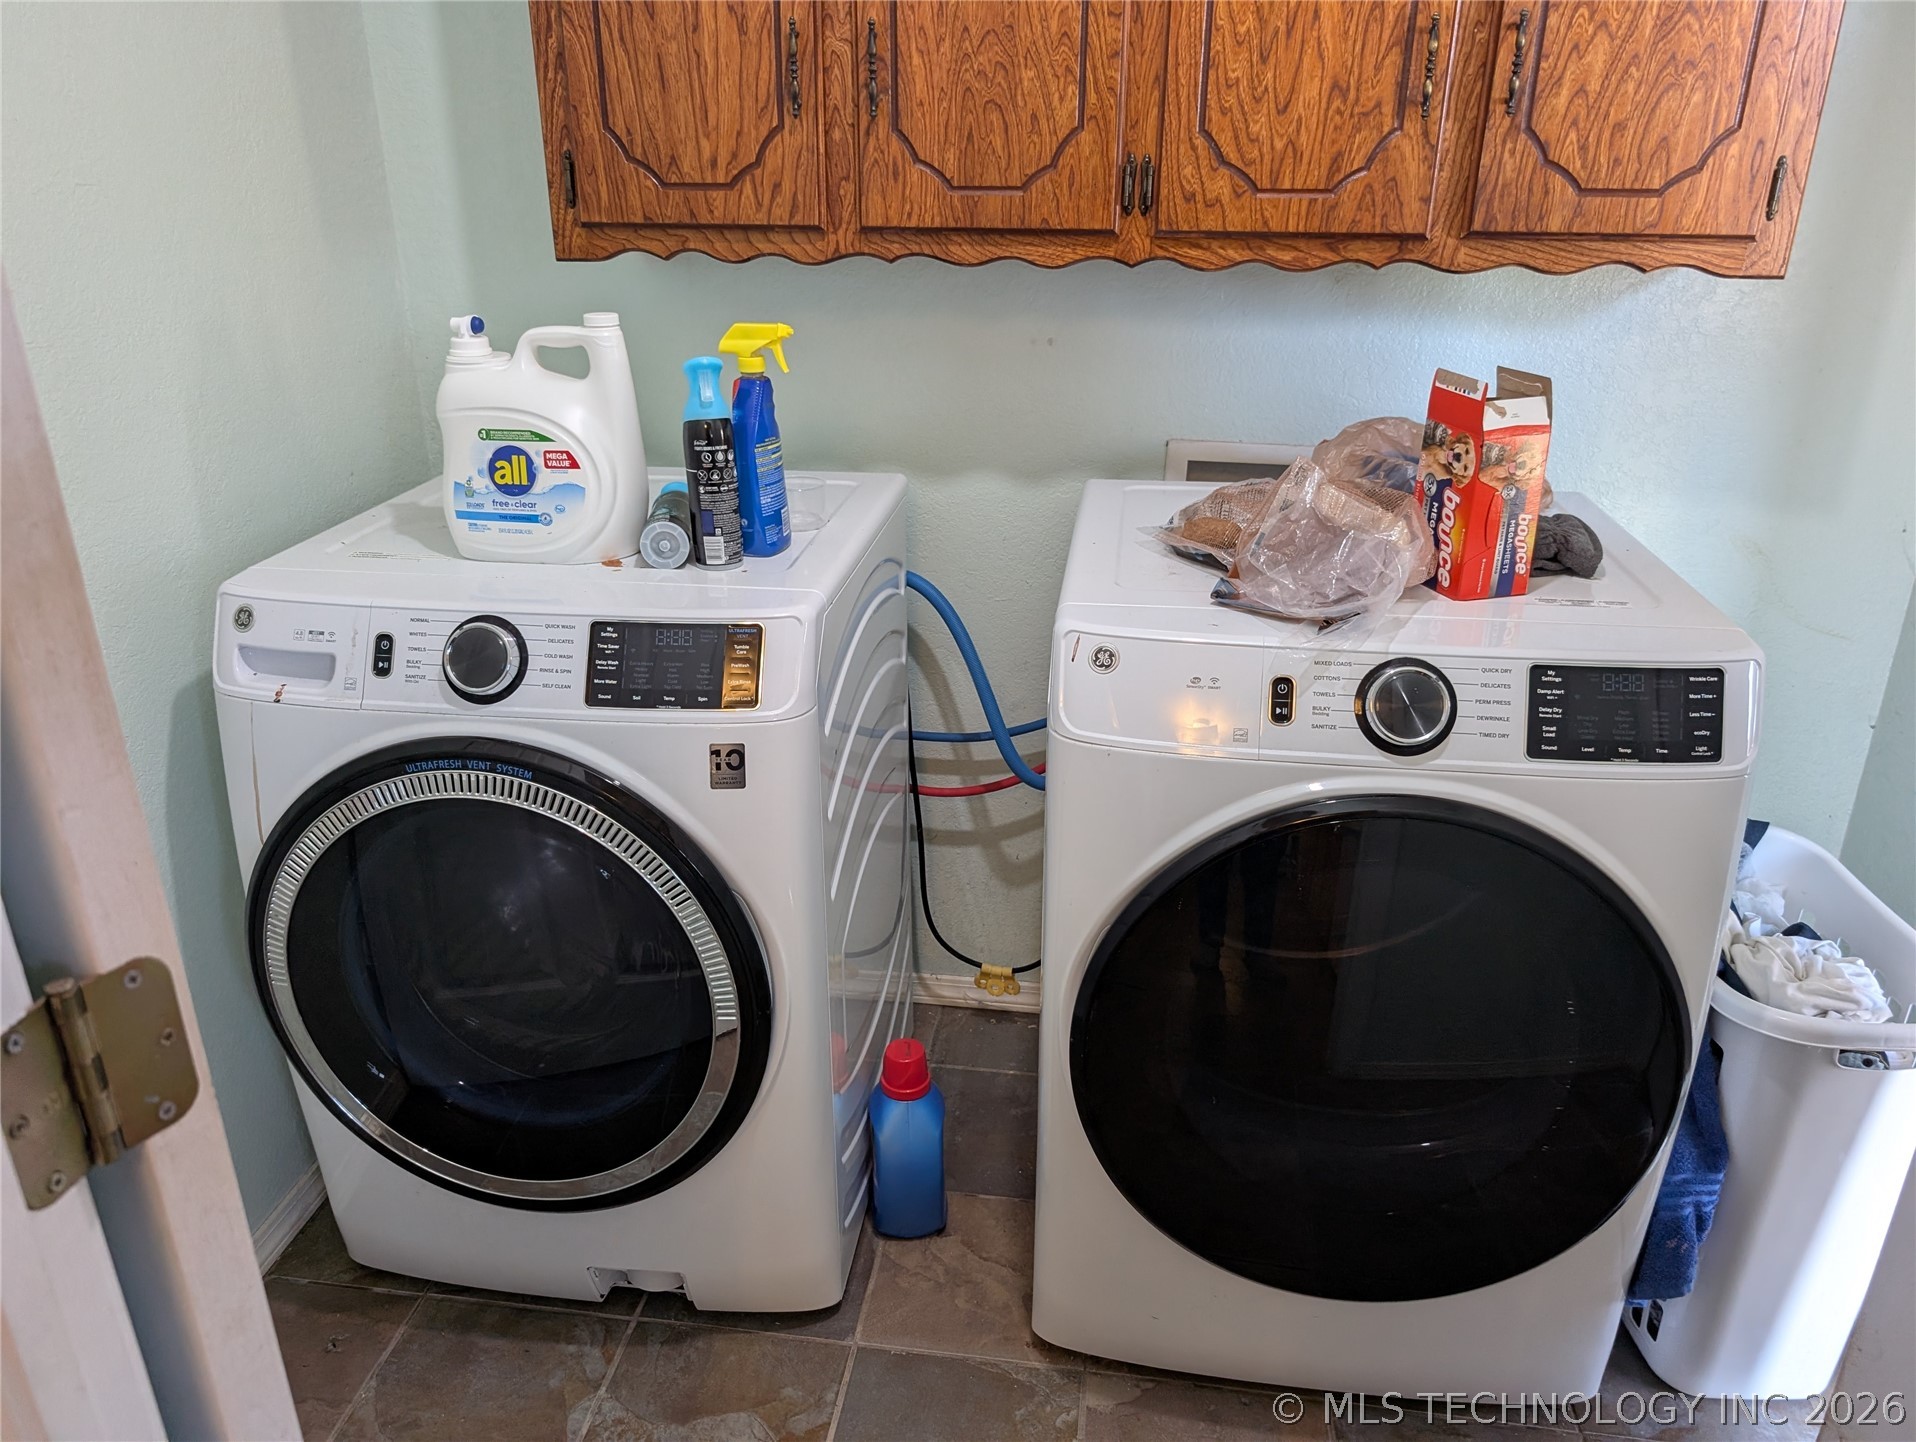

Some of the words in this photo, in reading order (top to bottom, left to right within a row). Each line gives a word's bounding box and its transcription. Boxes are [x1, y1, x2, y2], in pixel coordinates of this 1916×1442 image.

[494, 455, 527, 485] all
[492, 499, 509, 508] free
[514, 500, 537, 508] clear
[1438, 489, 1461, 588] bounce
[1502, 520, 1516, 574] MEGASHEETS
[1515, 514, 1531, 574] bounce
[406, 760, 461, 772] ULTRAFRESH
[467, 760, 491, 770] VENT
[496, 764, 532, 779] SYSTEM
[711, 749, 744, 771] 10
